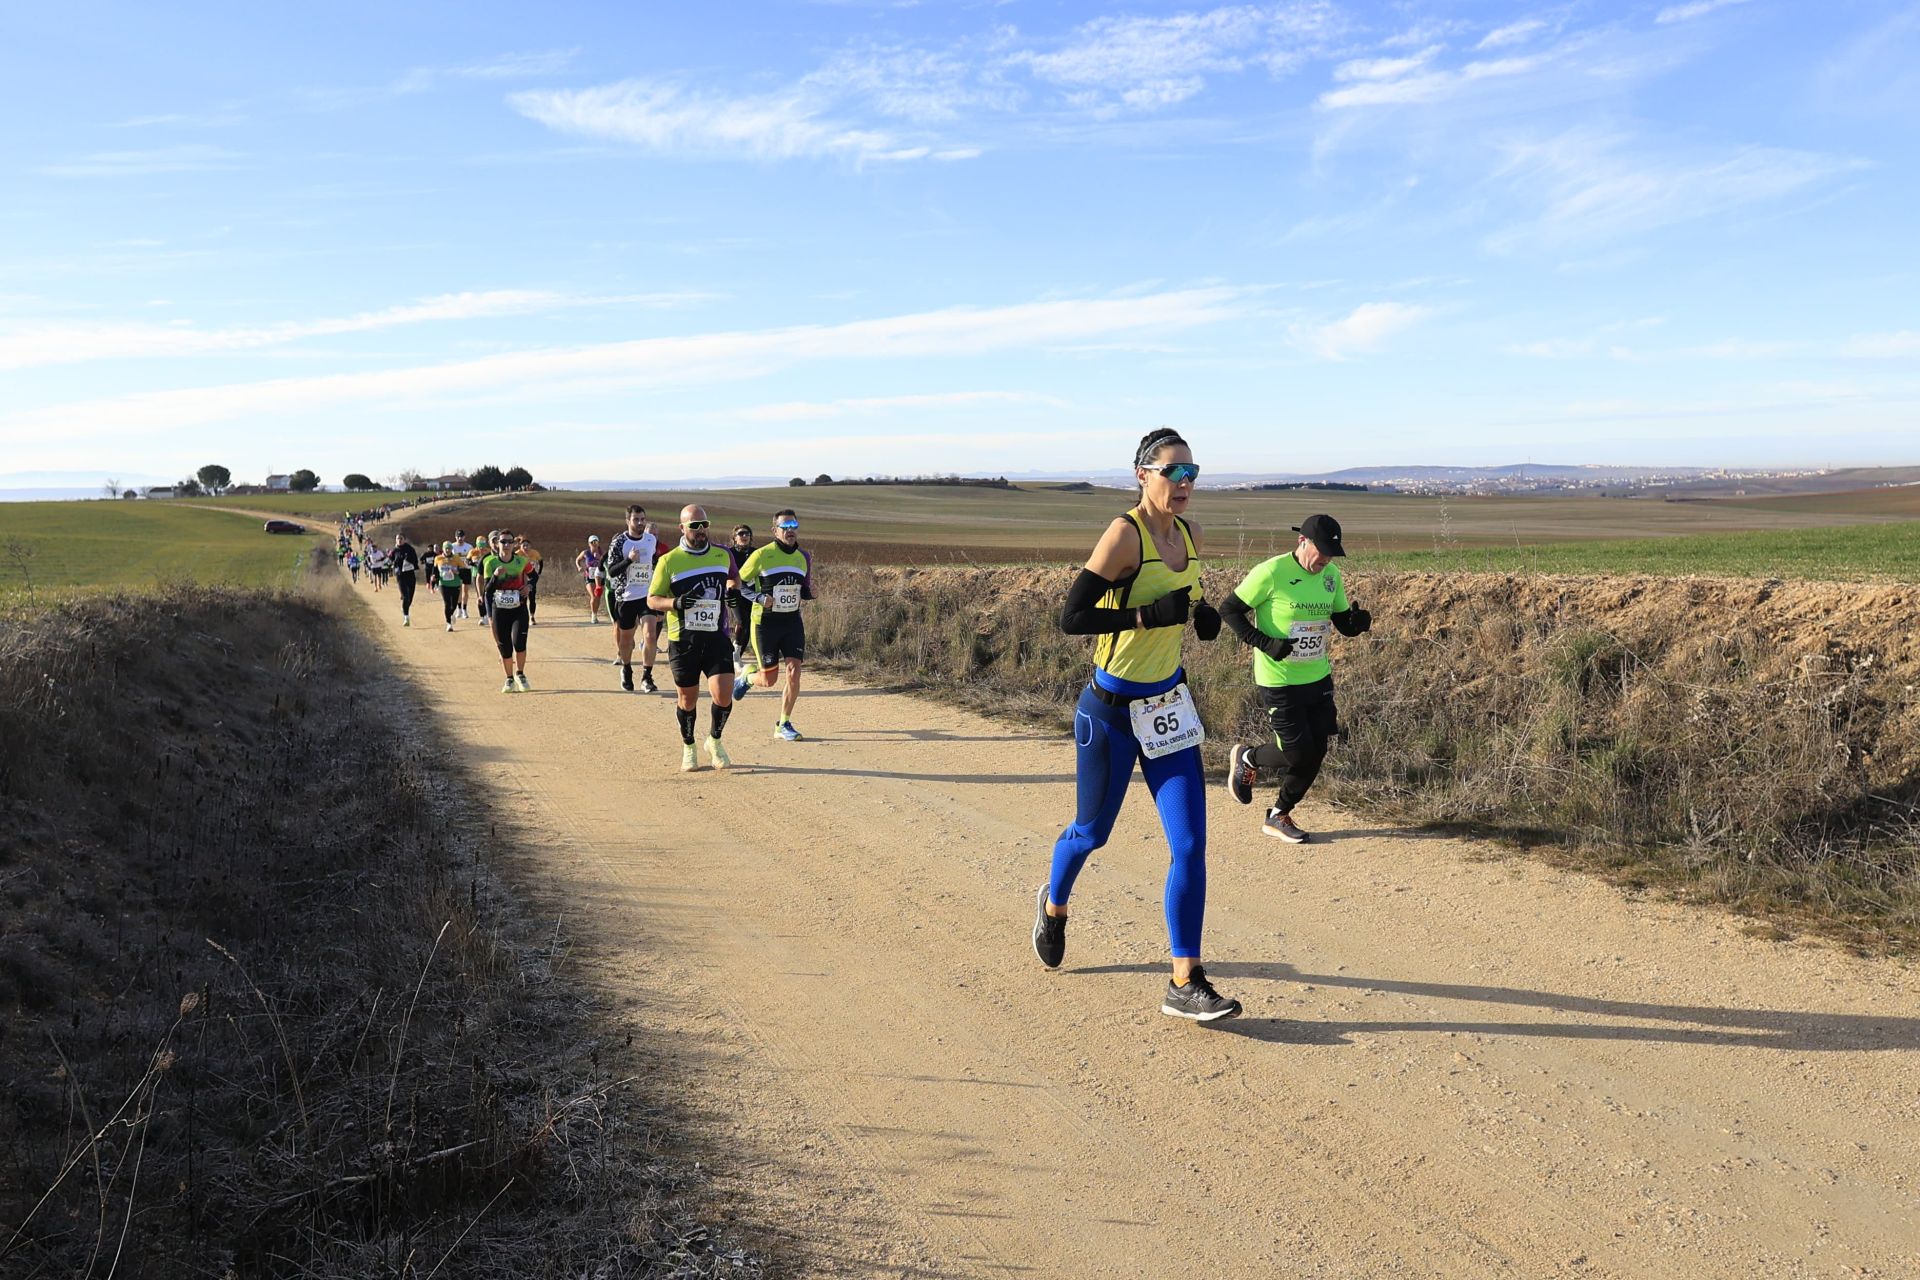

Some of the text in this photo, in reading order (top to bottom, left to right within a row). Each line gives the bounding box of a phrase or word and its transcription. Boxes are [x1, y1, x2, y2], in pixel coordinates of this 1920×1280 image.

[780, 594, 797, 604] 605
[694, 611, 714, 622] 194
[1299, 635, 1323, 650] 553
[1153, 712, 1180, 736] 65
[1156, 740, 1169, 748] LIGA
[1169, 735, 1187, 745] CROSS
